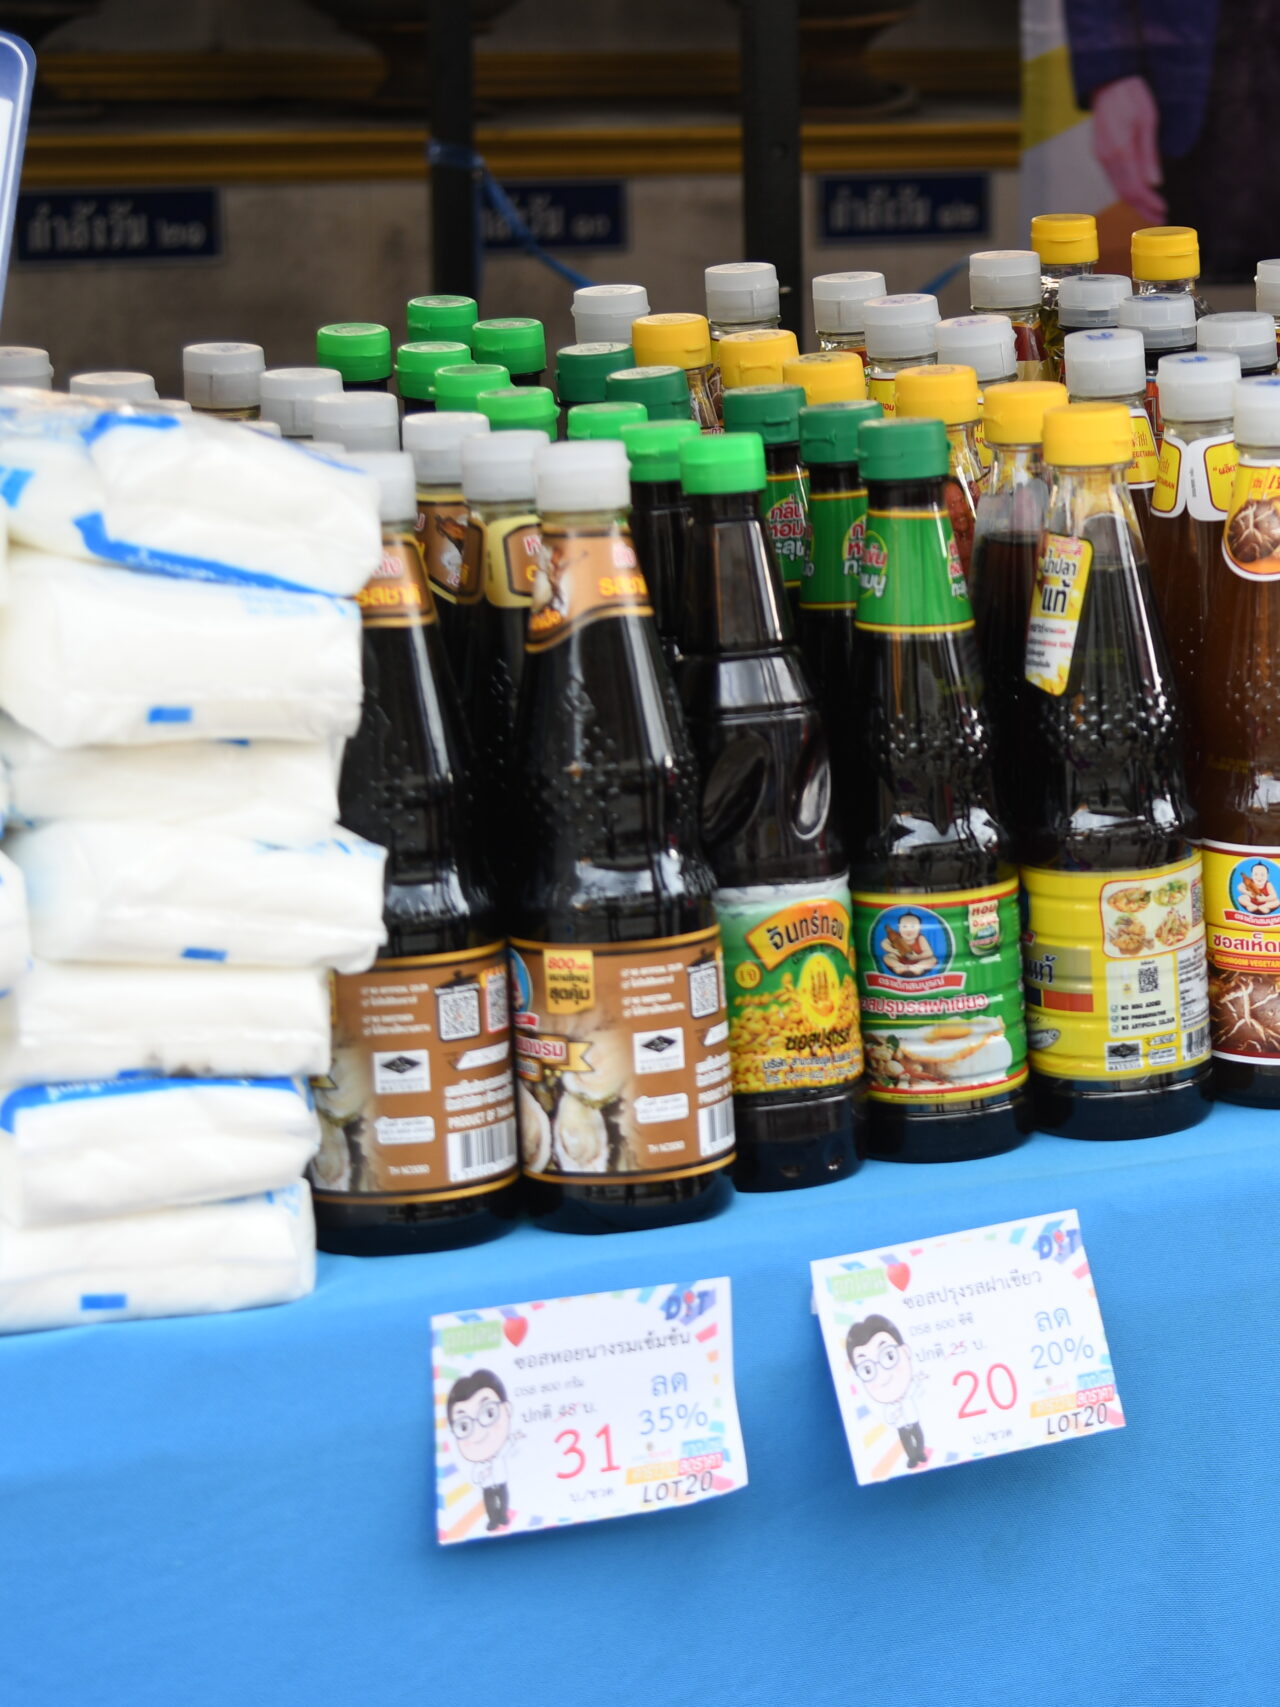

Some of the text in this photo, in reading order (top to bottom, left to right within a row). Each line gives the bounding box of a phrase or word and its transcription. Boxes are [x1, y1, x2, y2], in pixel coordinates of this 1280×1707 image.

[1041, 578, 1071, 614] แท้
[902, 1267, 1043, 1310] ซอสปรุงรสฝาเขียว
[1034, 1306, 1072, 1333] ลด
[514, 1327, 692, 1370] ซอสหอยนางรมเข้มข้น
[915, 1342, 946, 1363] ปกติ
[1031, 1335, 1095, 1371] 20%
[650, 1371, 688, 1398] ลด
[952, 1362, 1018, 1420] 20
[638, 1402, 709, 1437] 35%
[554, 1423, 621, 1480] 31
